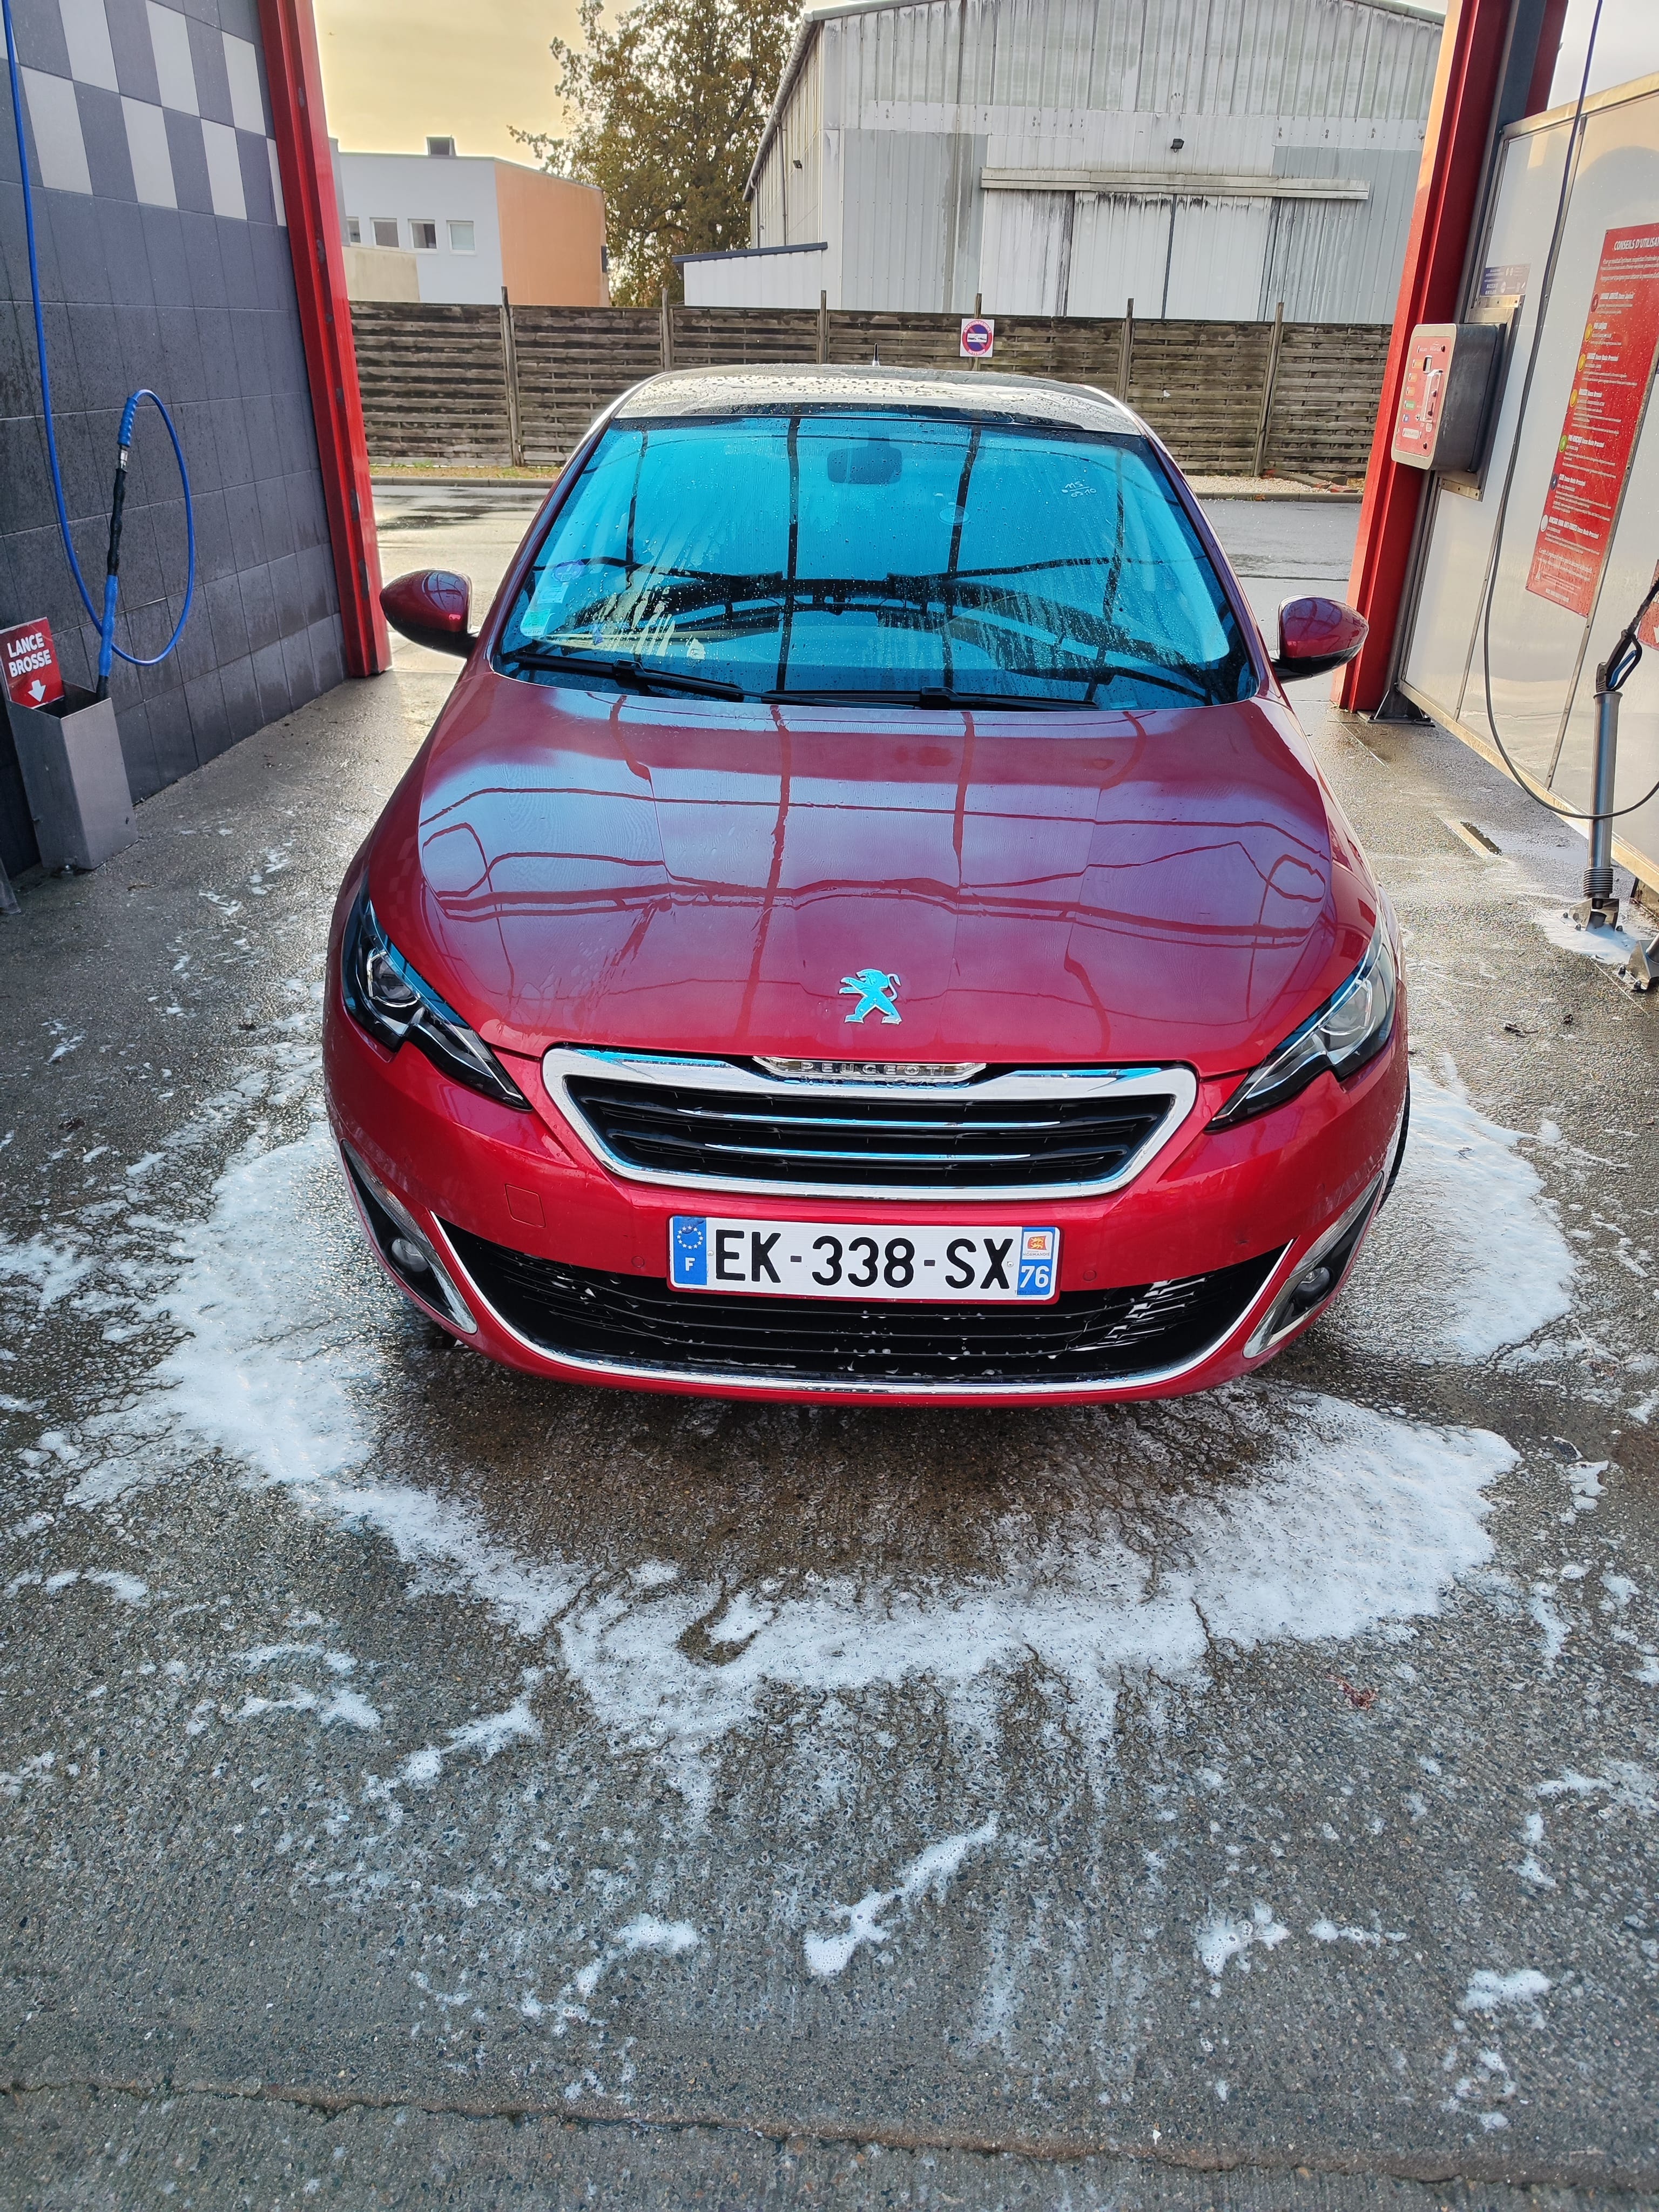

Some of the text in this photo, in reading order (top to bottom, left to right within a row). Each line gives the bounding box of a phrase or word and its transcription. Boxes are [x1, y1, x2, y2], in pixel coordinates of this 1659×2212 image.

[1614, 239, 1635, 251] CONSEILS
[7, 632, 44, 658] LANCE
[9, 649, 52, 677] BROSSE
[800, 1062, 941, 1076] PEUGEOT
[685, 1257, 696, 1271] F
[1020, 1265, 1050, 1288] 76
